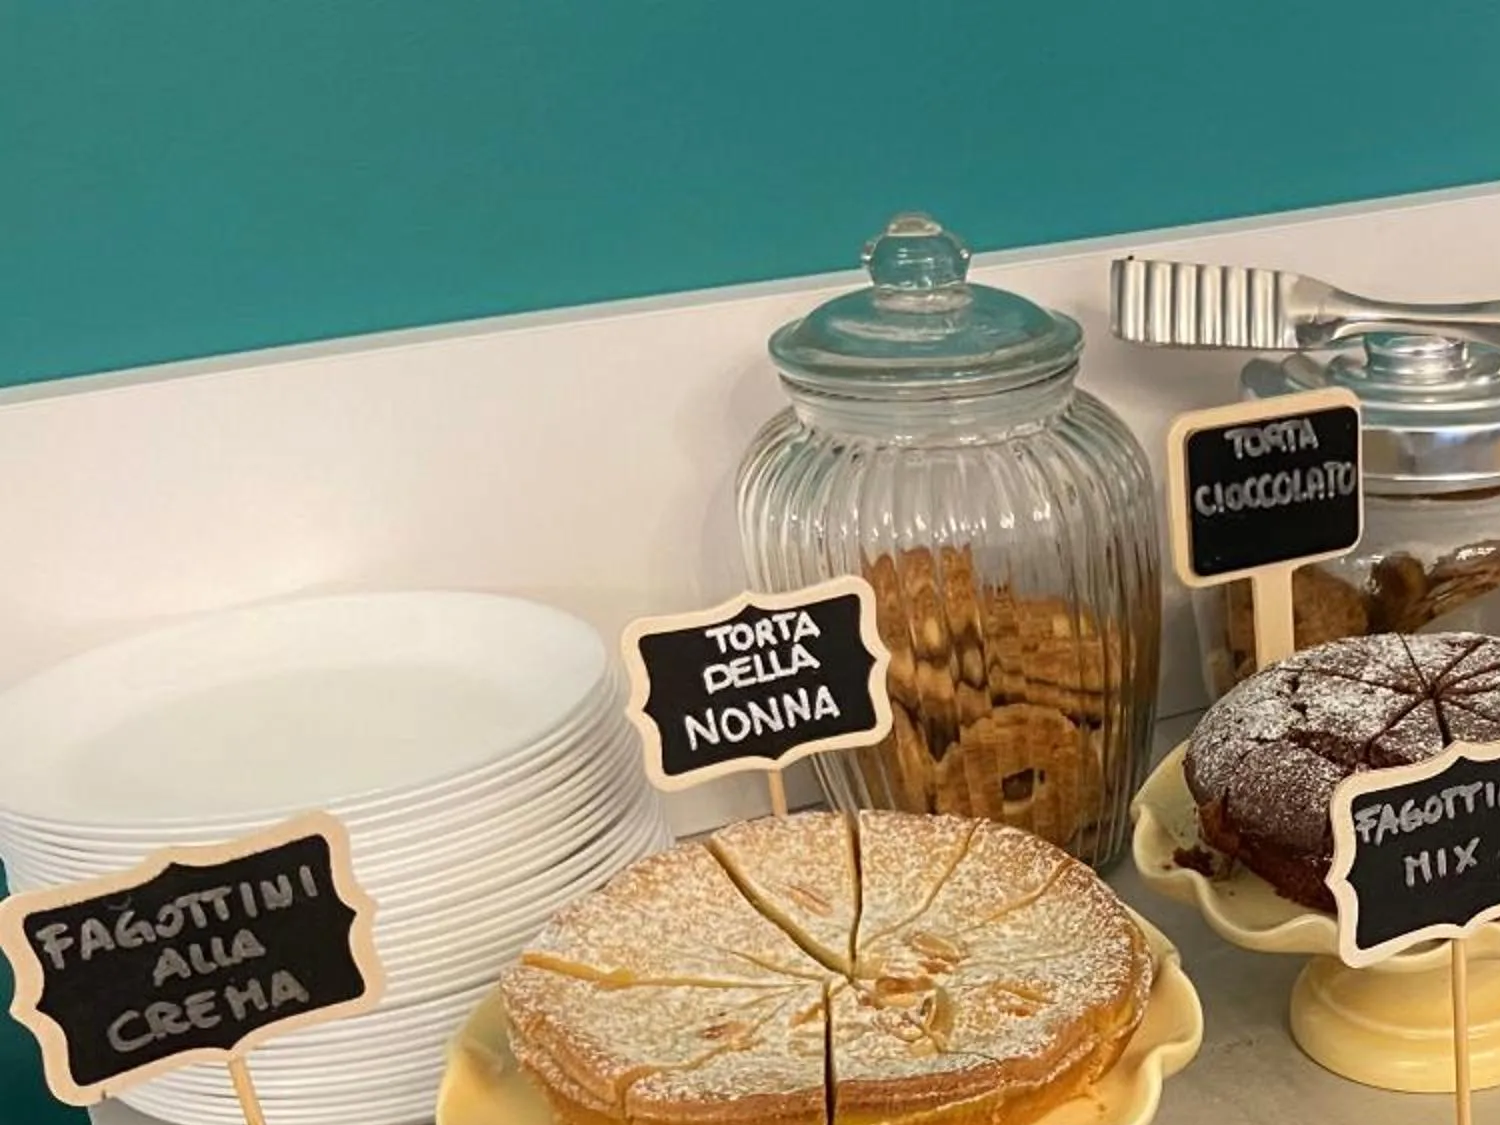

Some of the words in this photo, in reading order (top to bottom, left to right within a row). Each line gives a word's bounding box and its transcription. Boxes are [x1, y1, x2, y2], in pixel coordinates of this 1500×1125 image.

[1224, 417, 1319, 460] TORTA
[1195, 461, 1356, 517] CIOCCOLATO
[705, 611, 820, 654] TORTA
[703, 644, 820, 695] DELLA
[684, 685, 840, 751] NONNA
[1403, 837, 1480, 887] MIX
[35, 865, 319, 970] FAGOTTINI
[153, 928, 266, 987] ALLA
[106, 969, 310, 1053] CREMA
